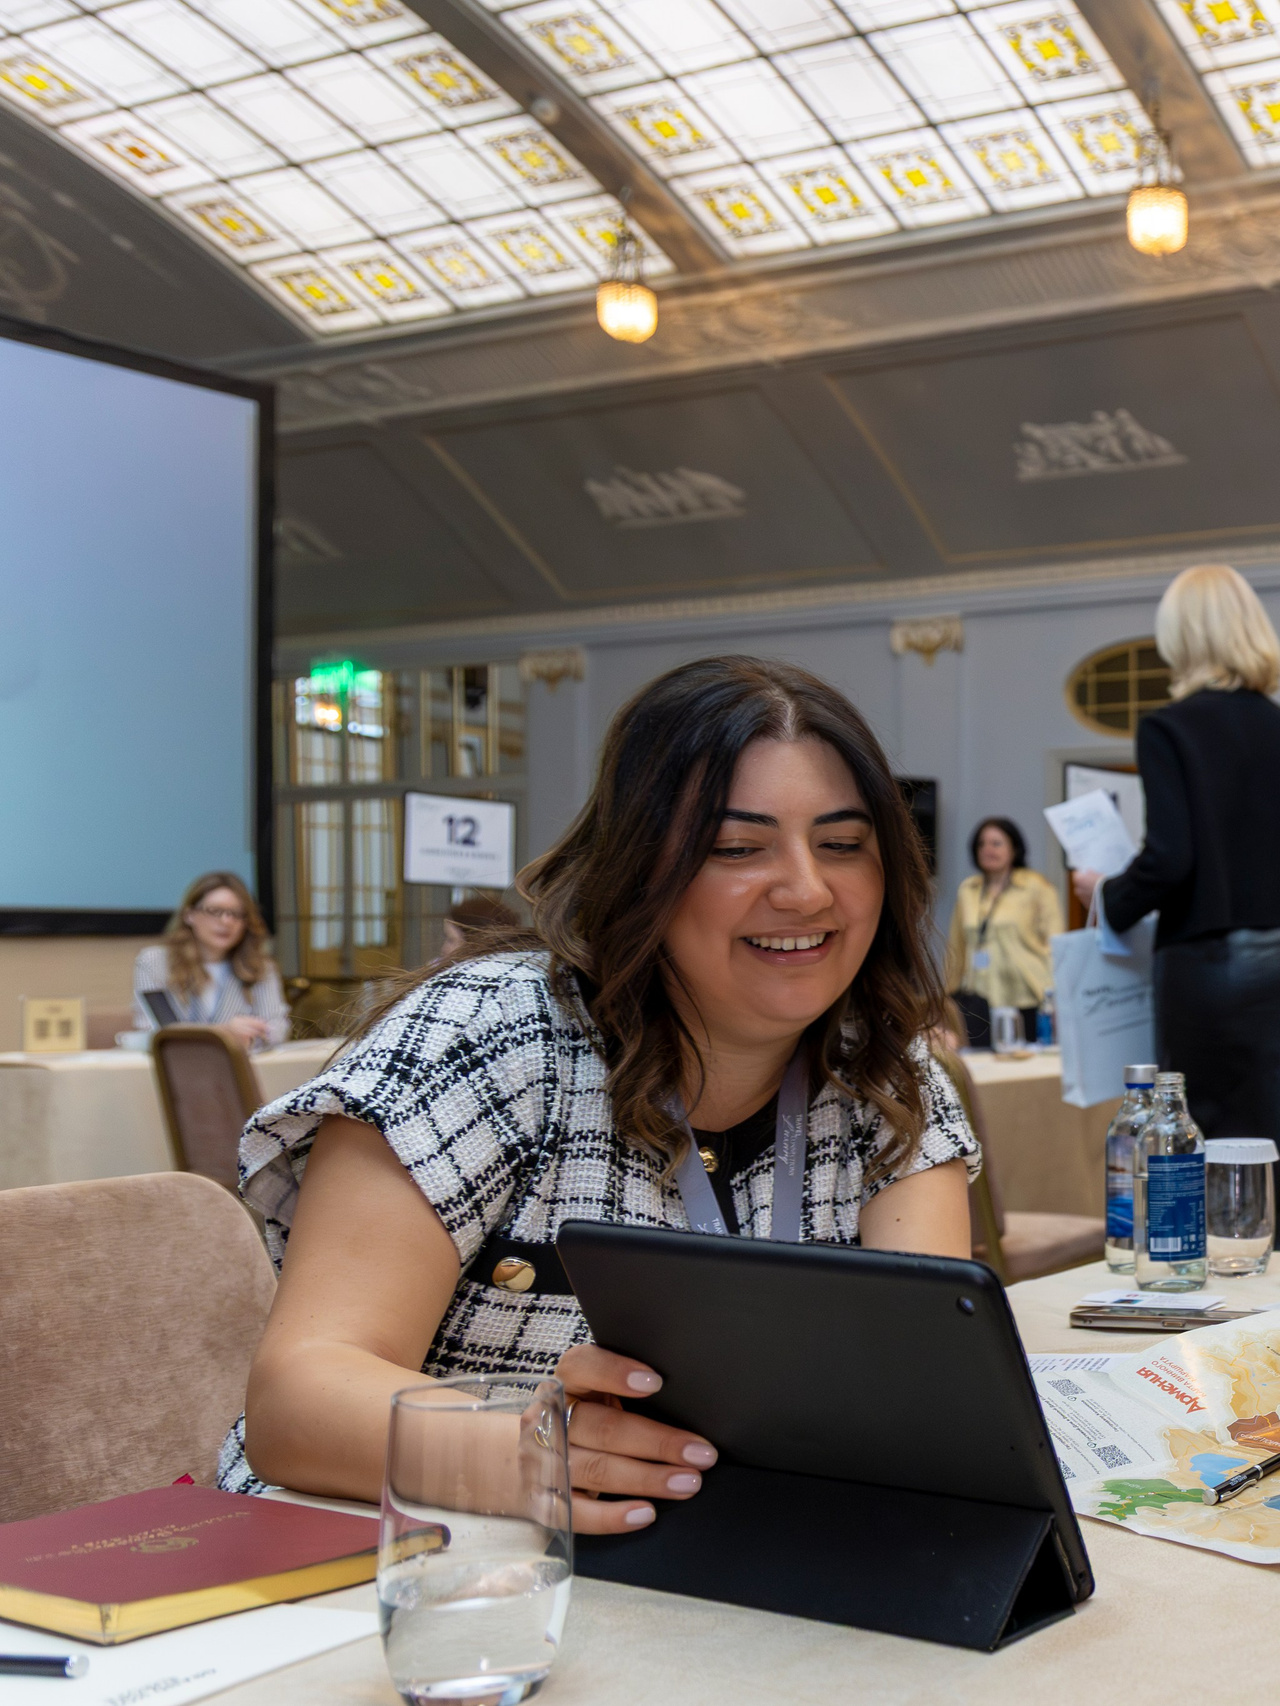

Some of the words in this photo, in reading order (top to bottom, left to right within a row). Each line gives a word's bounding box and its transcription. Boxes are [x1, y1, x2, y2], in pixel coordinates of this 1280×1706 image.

[443, 815, 477, 846] 12
[778, 1114, 795, 1165] Luxury
[795, 1114, 803, 1137] TRAVEL
[1151, 1360, 1185, 1383] ВИННОГО
[1160, 1356, 1197, 1382] МАРШРУТА
[1136, 1367, 1207, 1414] Армения
